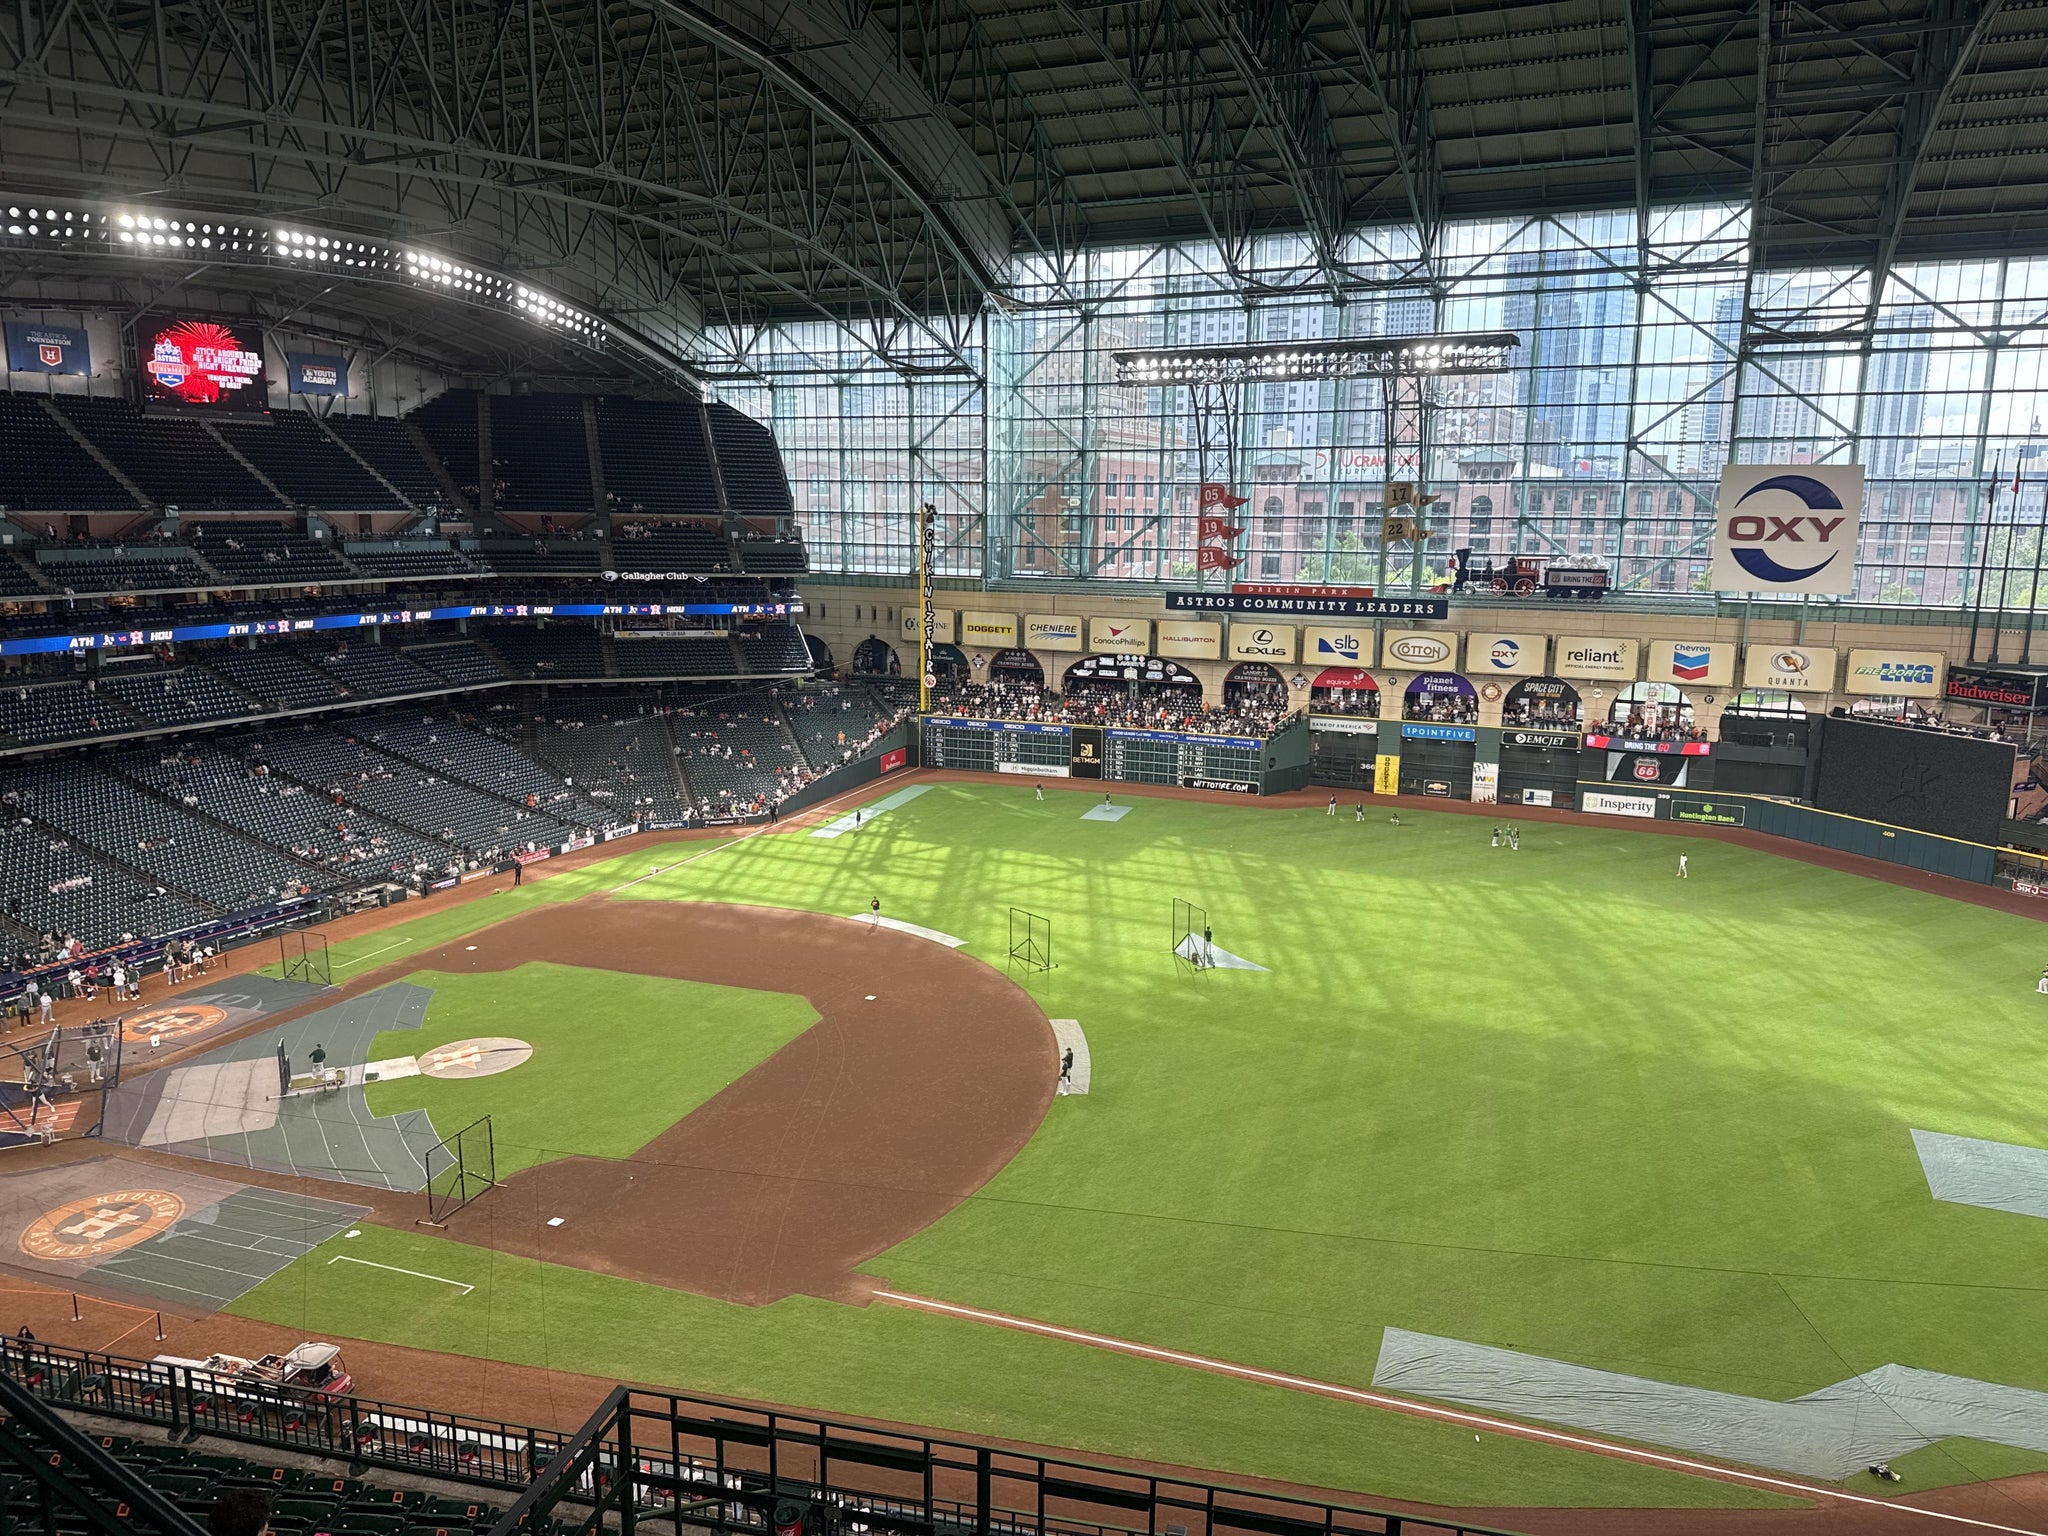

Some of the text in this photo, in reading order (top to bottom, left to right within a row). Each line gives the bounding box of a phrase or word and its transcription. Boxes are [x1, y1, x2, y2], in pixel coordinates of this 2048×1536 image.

[26, 336, 71, 346] FOUNDATION
[157, 354, 181, 363] ASTROS
[195, 347, 259, 361] STICK AROUND FOR
[193, 353, 205, 362] BIG
[213, 355, 238, 366] BRIGHT
[239, 358, 262, 368] FRIDAY
[198, 361, 259, 375] NIGHT FIREWORKS
[303, 375, 337, 386] ACADEMY
[314, 370, 337, 379] YOUTH
[1204, 488, 1219, 502] 05
[1391, 487, 1407, 501] 17
[1204, 521, 1218, 533] 19
[1388, 523, 1403, 536] 22
[1728, 515, 1846, 543] OXY
[1202, 551, 1215, 563] 21
[923, 528, 934, 599] CHIKIN
[621, 572, 689, 581] Gallagher Club
[1248, 586, 1301, 594] DAIKIN
[470, 606, 487, 615] ATH
[533, 606, 553, 615] HOU
[602, 606, 622, 614] ATH
[666, 605, 685, 613] HOU
[790, 605, 804, 613] HO
[1176, 595, 1435, 614] ASTROS COMMUNITY LEADERS
[359, 614, 377, 624] ATH
[415, 610, 431, 620] HOU
[228, 625, 249, 635] ATH
[294, 619, 314, 630] HOU
[967, 624, 1013, 634] DOGGETT
[1029, 622, 1078, 634] CHENIERE
[69, 636, 94, 648] ATH
[150, 630, 173, 642] HOU
[1093, 636, 1146, 648] ConocoPhillips
[1162, 635, 1216, 643] HALLIBURTON
[1334, 634, 1360, 650] slb
[1237, 646, 1287, 656] LEXUS
[1397, 642, 1441, 660] COTTON
[1491, 650, 1518, 658] OXY
[1674, 643, 1711, 653] Chevron
[1567, 648, 1620, 663] reliant
[1856, 666, 1923, 678] FREEPORT
[1880, 662, 1934, 684] LNG
[1423, 676, 1454, 685] planet
[1767, 677, 1809, 687] QUANTA
[1427, 683, 1459, 692] fitness
[1523, 682, 1566, 694] SPACE CITY
[1948, 681, 2031, 705] Budweiser
[1041, 725, 1063, 733] GEICO
[1406, 727, 1471, 739] 1POINTFIVE
[1526, 735, 1567, 747] EMCJET
[1624, 741, 1670, 752] BRING THE GO
[1072, 756, 1101, 764] BETMGM
[1638, 766, 1654, 776] 66
[1475, 775, 1495, 783] WM
[1193, 780, 1249, 793] NITTOTIRE.COM
[1600, 797, 1653, 813] Insperity
[1679, 811, 1735, 823] Huntington Bank
[649, 822, 685, 830] AmegyBank
[1882, 830, 1896, 838] 409
[96, 1191, 173, 1219] HOUSTON
